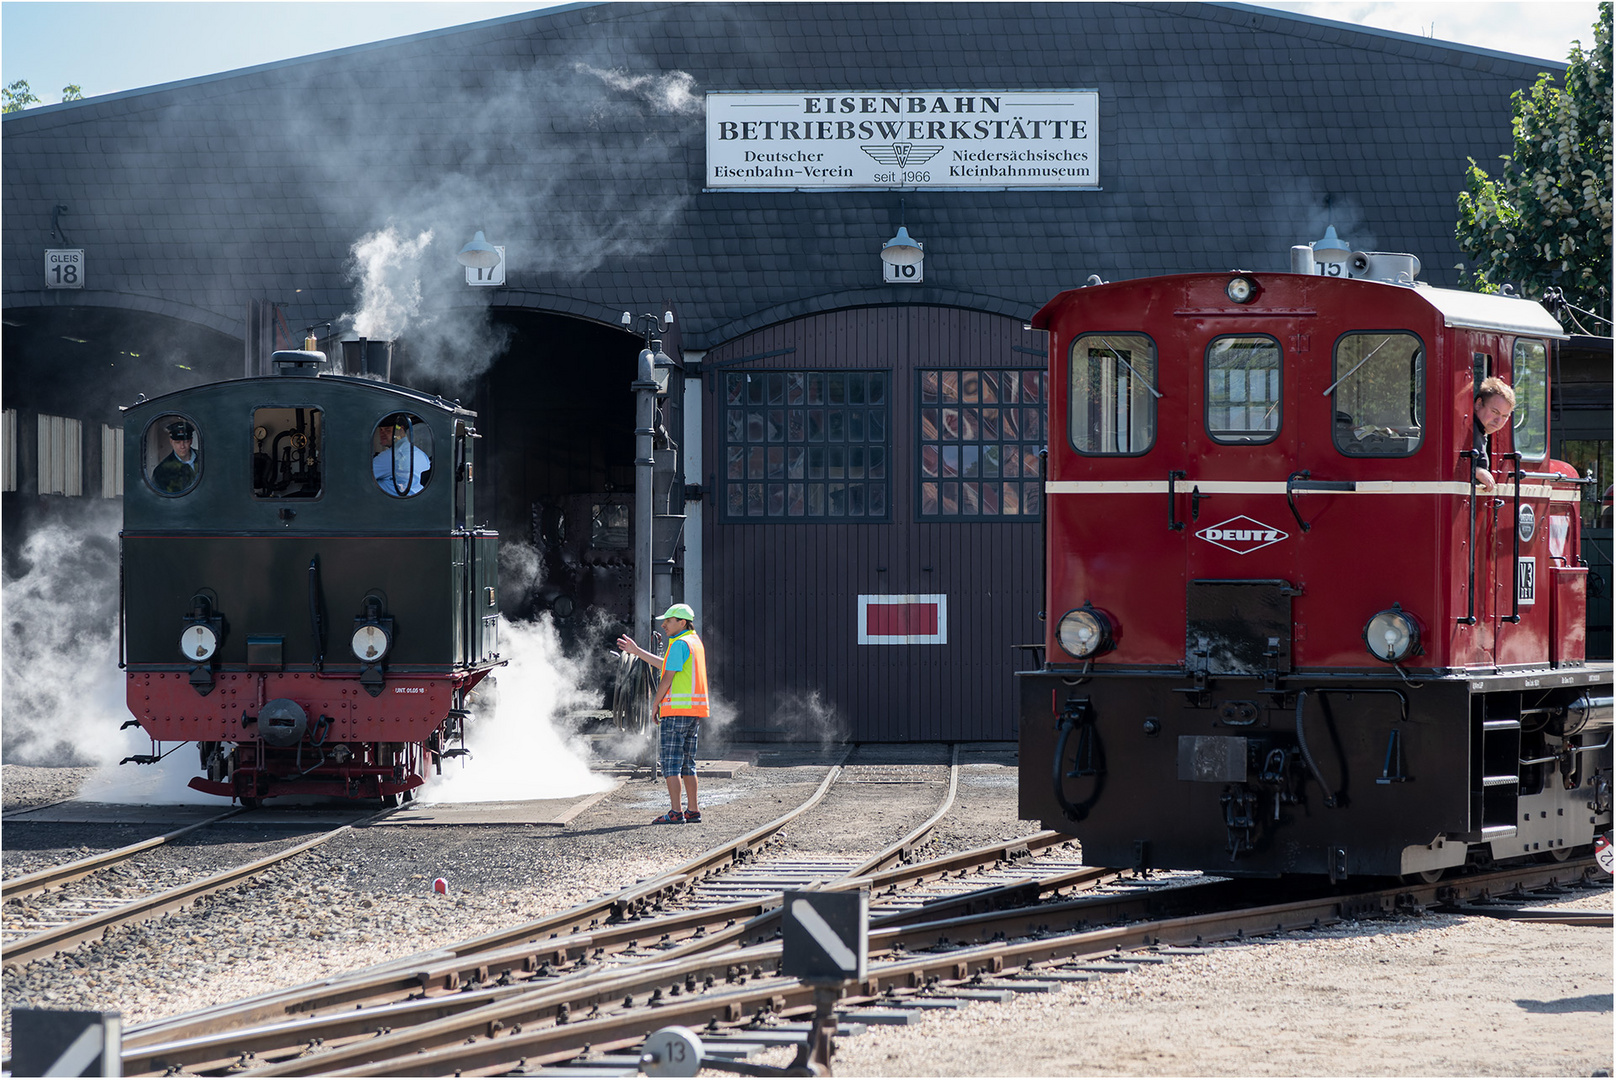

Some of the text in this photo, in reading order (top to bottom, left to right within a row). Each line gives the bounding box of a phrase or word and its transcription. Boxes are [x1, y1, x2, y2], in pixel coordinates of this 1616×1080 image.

[803, 97, 1001, 114] EISENBAHN
[717, 116, 1088, 140] BETRIEBSWERKSTÄTTE
[744, 150, 824, 162] Deutscher
[952, 149, 1088, 162] Niedersächsisches
[714, 165, 853, 178] Eisenbahn-Verein
[873, 171, 931, 183] seit 1966
[949, 165, 1090, 177] Kleinbahnmuseum
[50, 254, 79, 263] GLEIS
[52, 264, 77, 284] 18
[890, 263, 916, 278] 16
[1316, 261, 1341, 277] 15
[1206, 529, 1278, 541] DEUTZ
[666, 1041, 686, 1063] 13
